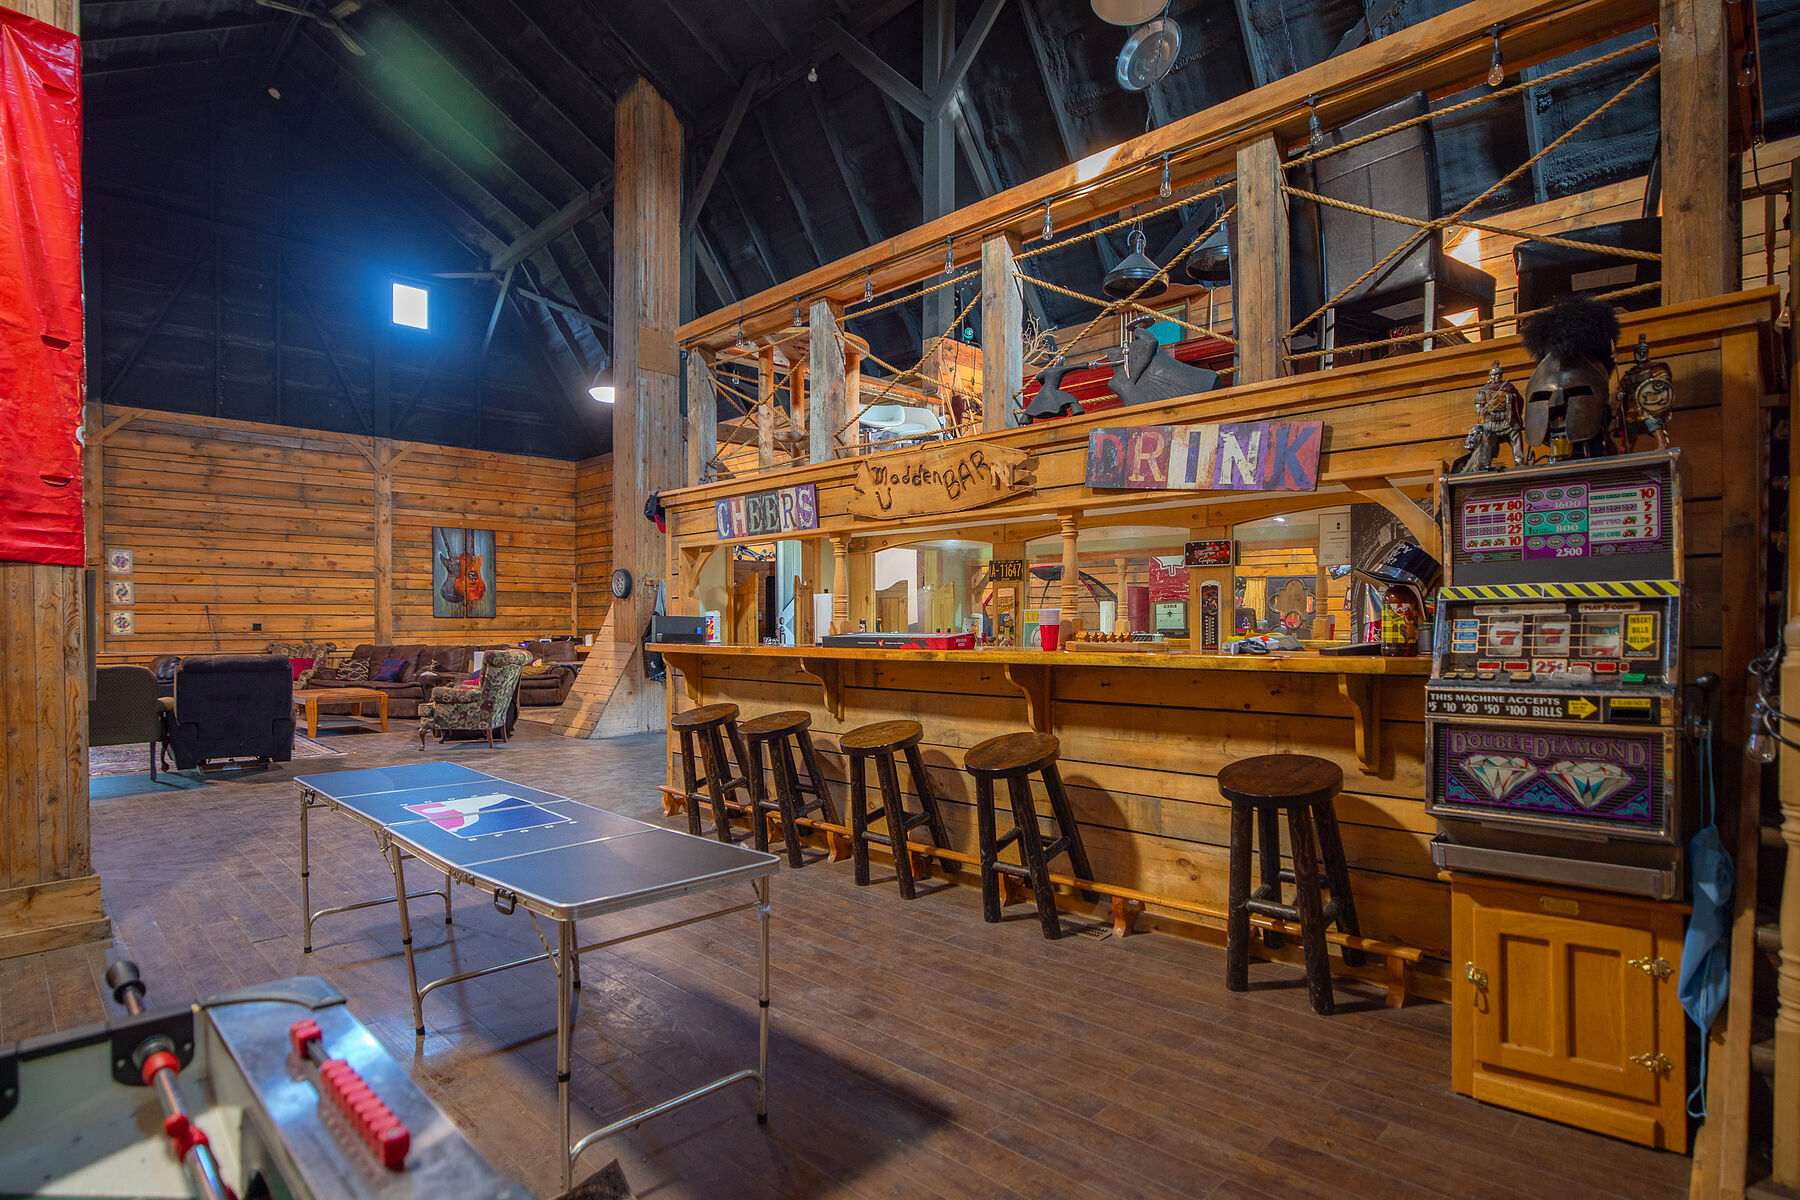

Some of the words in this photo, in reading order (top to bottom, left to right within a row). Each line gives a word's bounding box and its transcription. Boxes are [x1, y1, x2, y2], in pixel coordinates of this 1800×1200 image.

[1091, 427, 1317, 487] DRINK
[1640, 488, 1655, 499] 10
[1507, 500, 1523, 511] 80
[1644, 501, 1652, 512] 5
[717, 488, 814, 537] CHEERS
[1507, 512, 1523, 523] 40
[1644, 514, 1652, 524] 5
[1507, 524, 1522, 535] 25
[1555, 523, 1580, 533] 800
[1644, 526, 1653, 537] 2
[1509, 536, 1522, 546] 10
[991, 563, 1022, 577] A-11647
[1630, 616, 1651, 624] INSERT
[1430, 693, 1454, 702] THIS
[1456, 694, 1505, 703] MACHINE
[1507, 696, 1560, 706] ACCEPTS
[1443, 703, 1457, 712] $10
[1463, 703, 1478, 713] $20
[1484, 704, 1500, 714] $50
[1506, 705, 1527, 716] $100
[1532, 706, 1563, 717] BILLS
[1451, 732, 1532, 755] DOUBLE
[1532, 737, 1647, 767] DIAMOND
